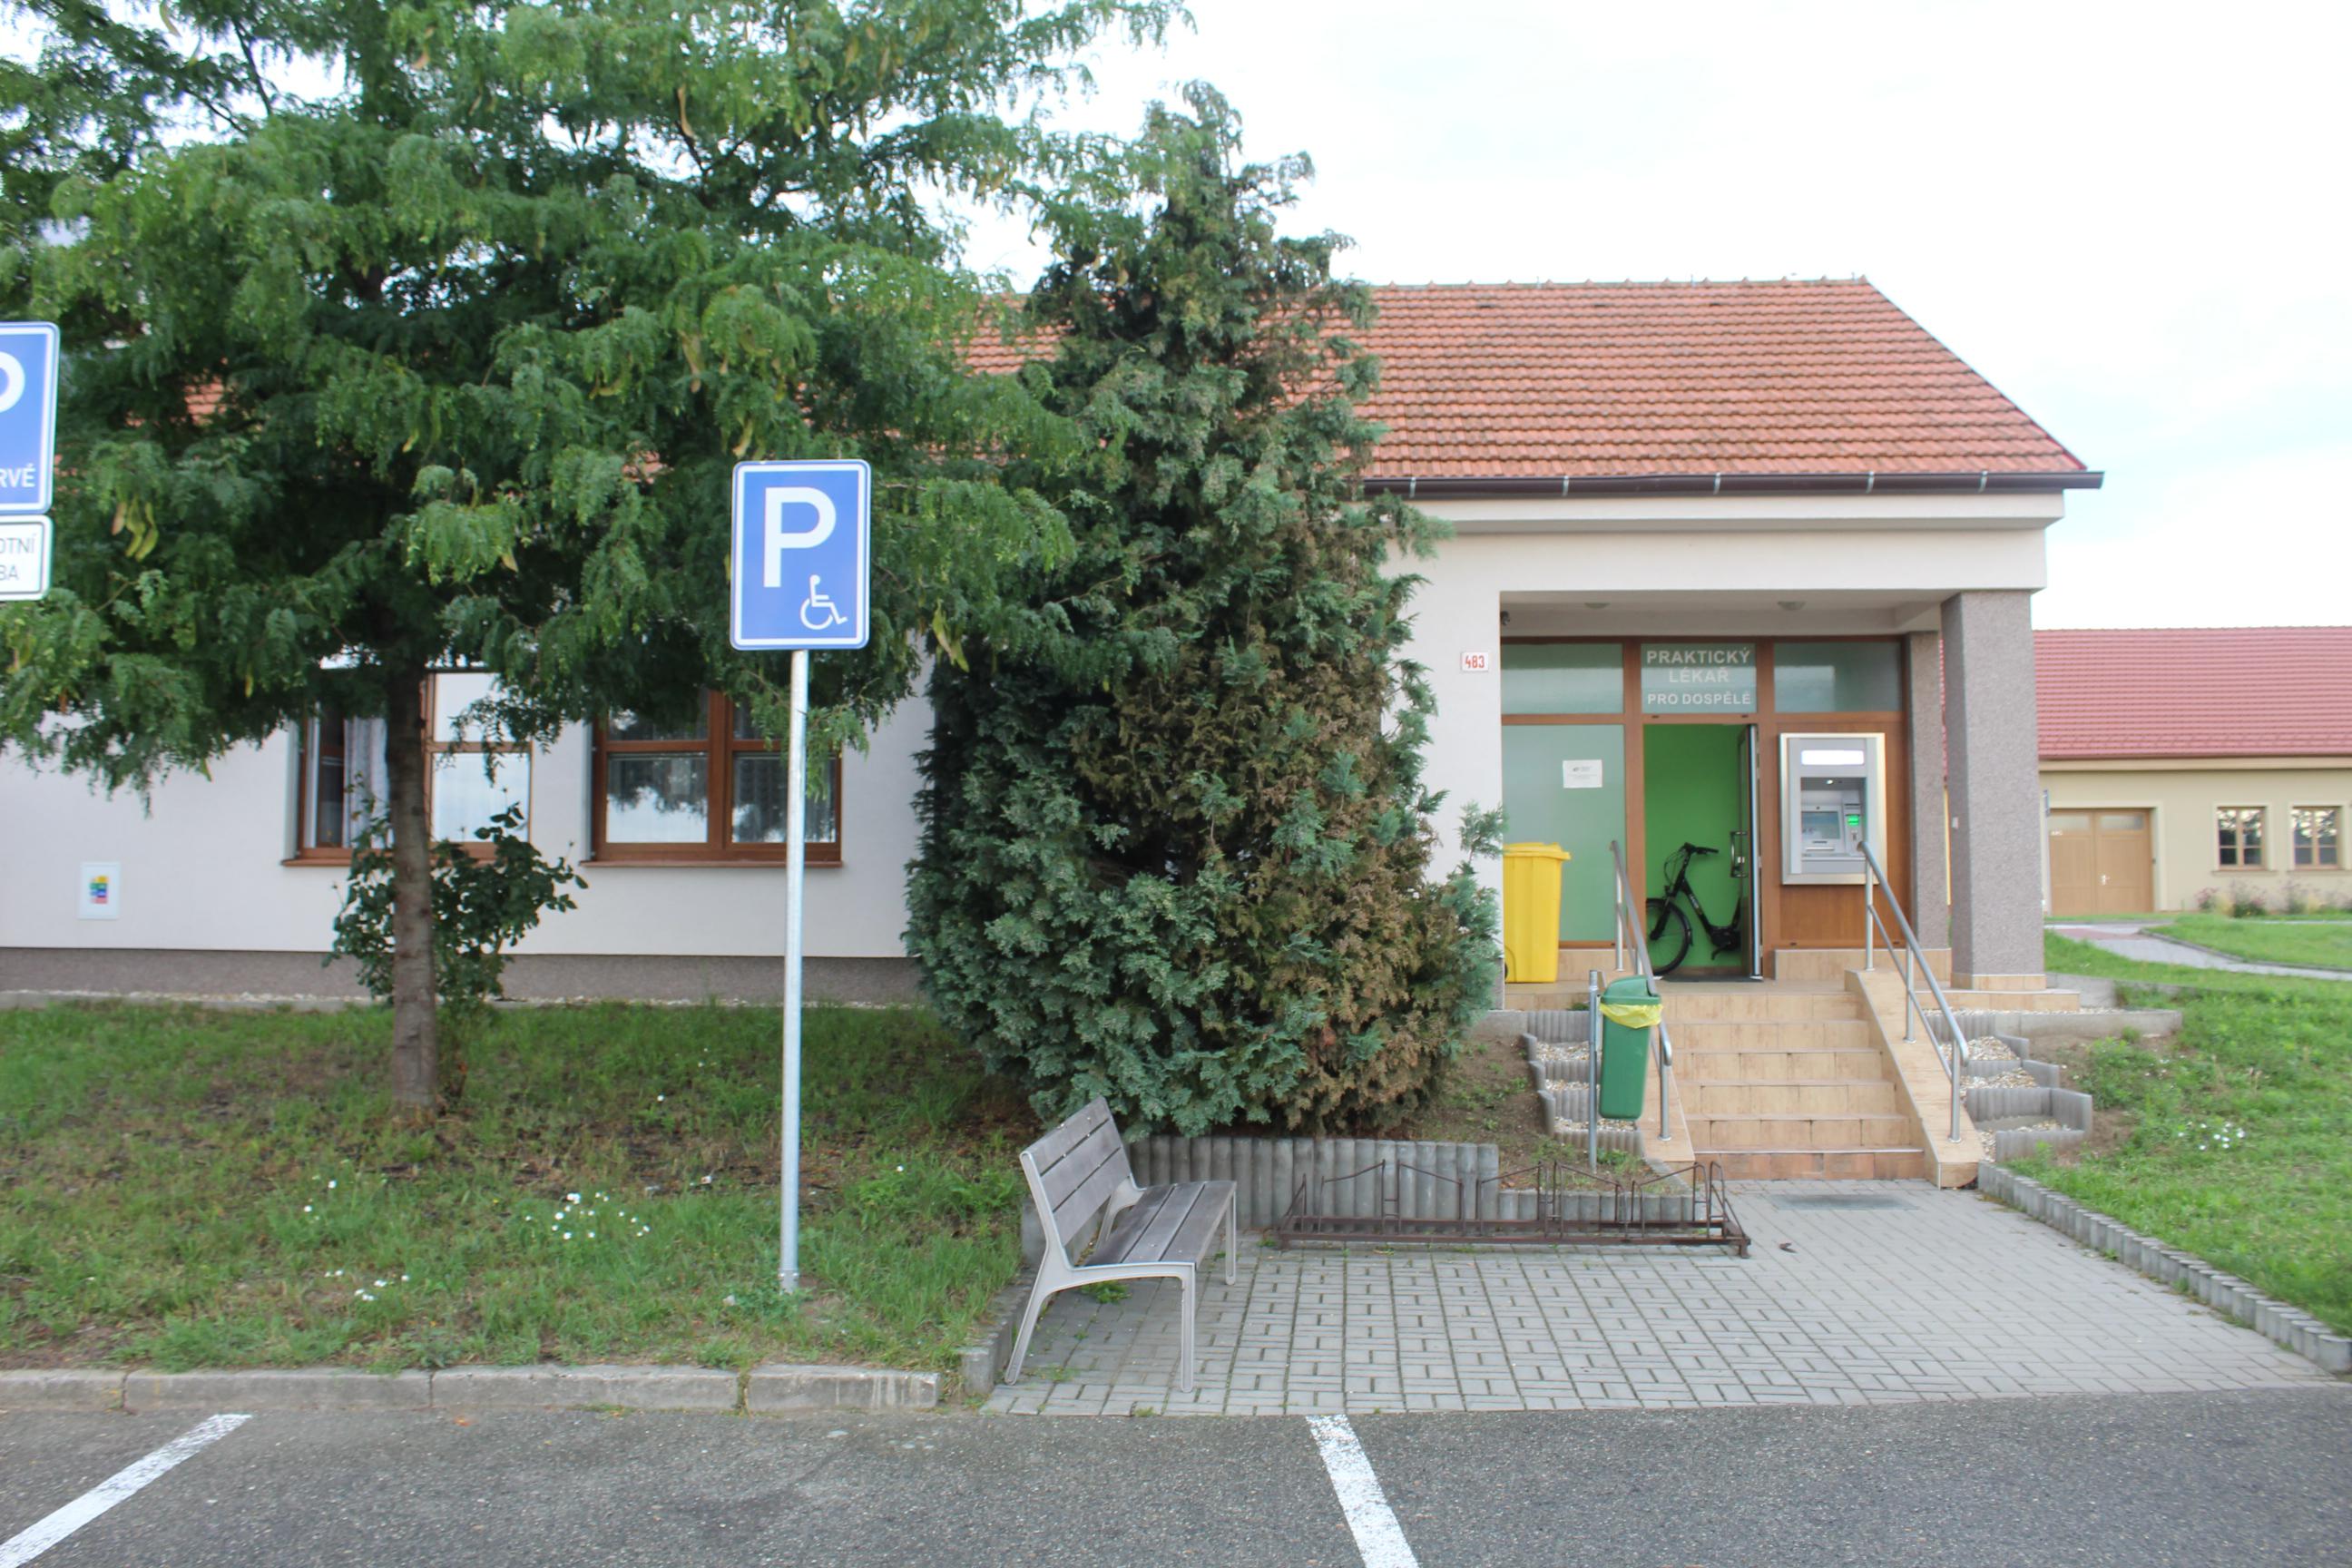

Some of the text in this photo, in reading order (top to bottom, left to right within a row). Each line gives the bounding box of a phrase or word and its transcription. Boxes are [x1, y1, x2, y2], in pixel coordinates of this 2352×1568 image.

[763, 486, 837, 588] P
[1465, 654, 1485, 669] 483
[1646, 647, 1750, 664] PRAKTICKÝ
[1669, 666, 1730, 683] LÉKAŘ
[1647, 691, 1751, 705] PRO DOSPĚLÉ
